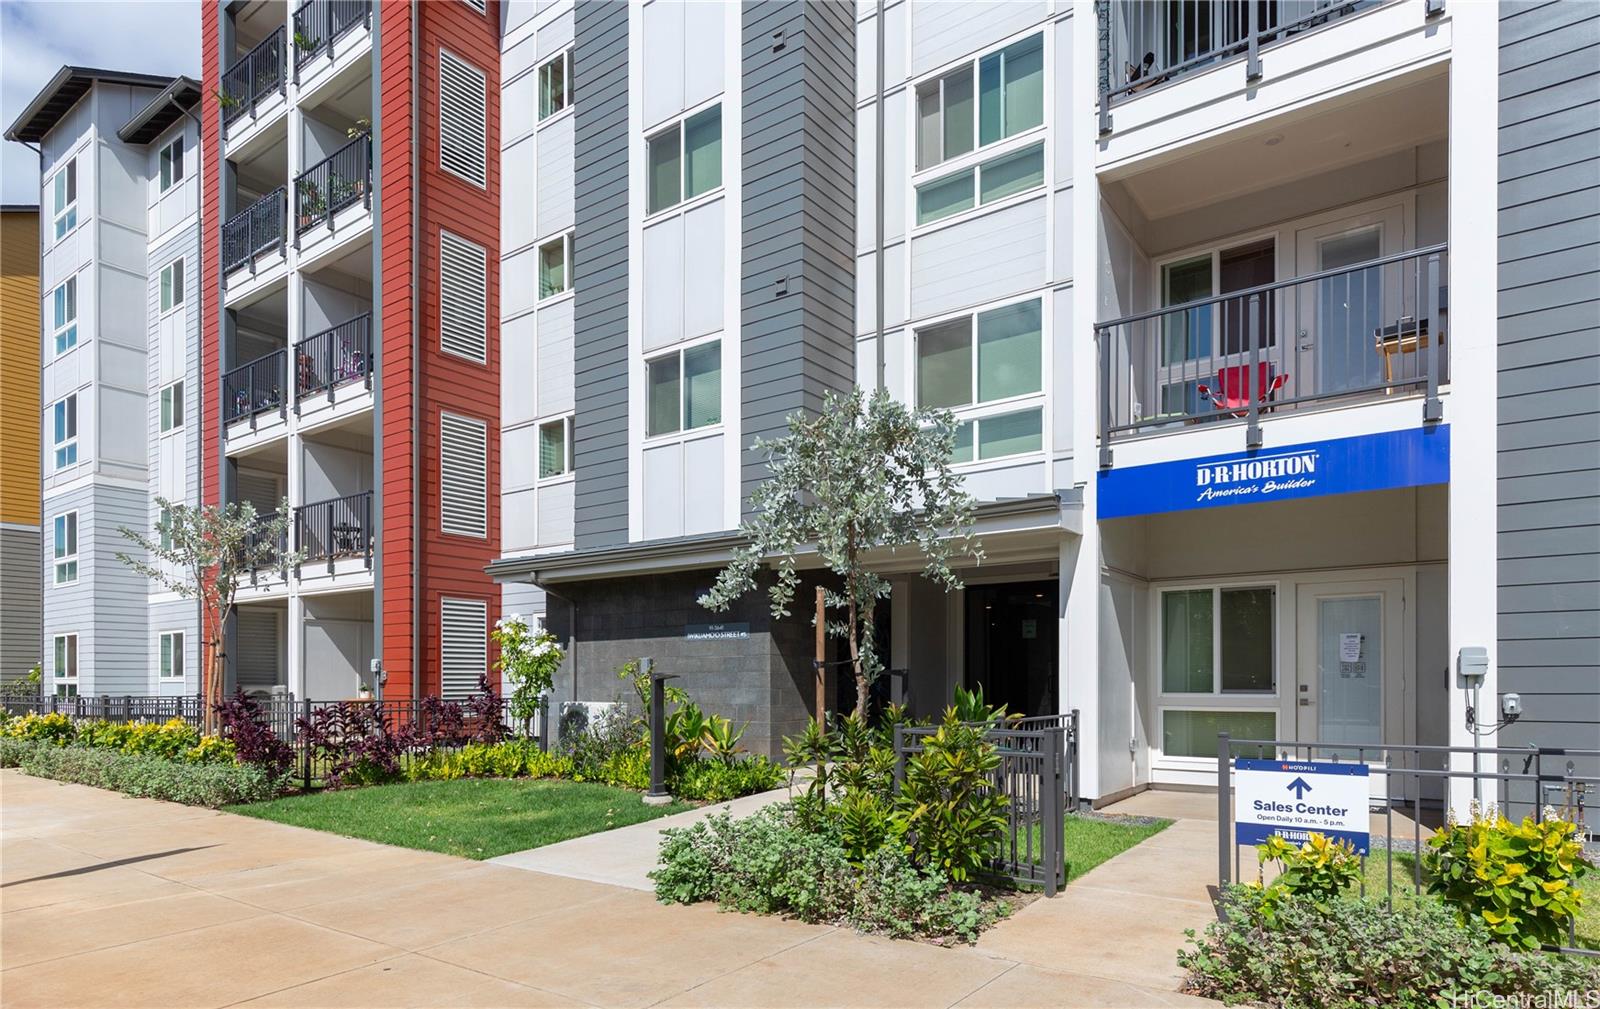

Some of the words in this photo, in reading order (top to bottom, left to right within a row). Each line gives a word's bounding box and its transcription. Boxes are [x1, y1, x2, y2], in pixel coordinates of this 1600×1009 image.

[1197, 484, 1259, 502] America's
[1261, 477, 1316, 494] Builder
[1253, 800, 1293, 813] Sales
[1296, 802, 1349, 817] Center
[1257, 814, 1276, 822] Open
[1276, 815, 1293, 824] Daily
[1329, 820, 1345, 828] p.m.
